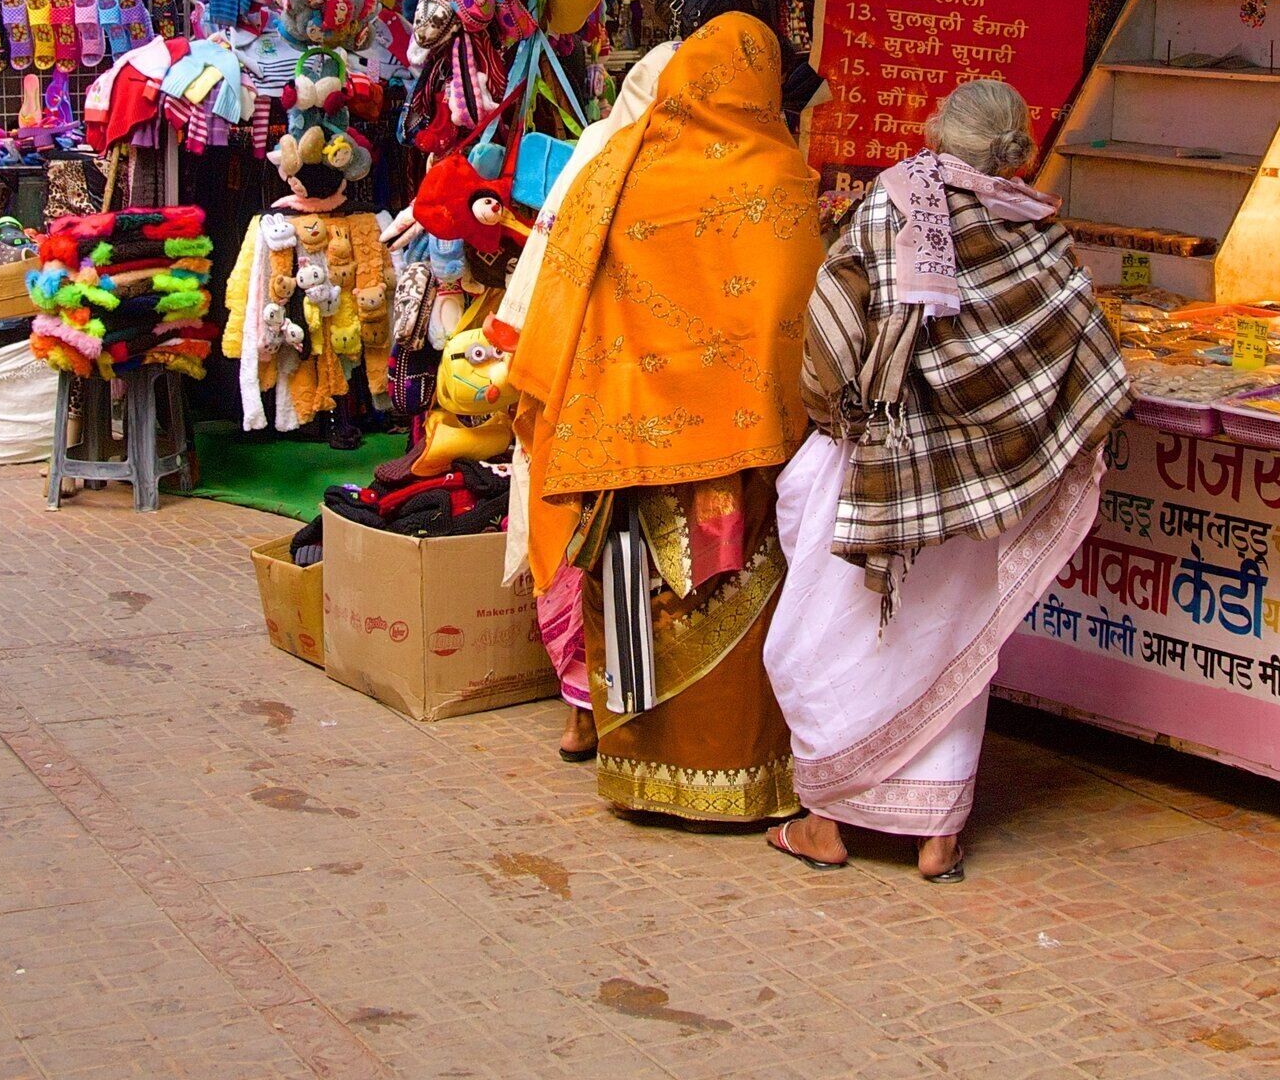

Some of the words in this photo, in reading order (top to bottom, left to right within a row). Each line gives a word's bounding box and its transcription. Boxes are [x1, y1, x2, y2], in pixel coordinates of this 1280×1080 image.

[845, 2, 877, 22] 13.
[886, 8, 966, 36] चुलबुली
[971, 14, 1030, 40] ईमली
[842, 29, 874, 49] 14.
[883, 36, 945, 59] सुरभी
[950, 44, 1017, 66] सुपारी
[839, 57, 871, 77] 15.
[880, 63, 949, 84] सन्तरा
[836, 85, 868, 104] 16.
[876, 85, 929, 110] सौंफ
[833, 113, 864, 131] 17.
[865, 138, 913, 161] मैथी
[1159, 500, 1210, 544] राम
[1209, 511, 1272, 570] लड्डू
[476, 607, 516, 619] Makers
[517, 604, 529, 614] of
[1086, 603, 1138, 658] गोली
[1139, 629, 1189, 672] आम
[1191, 642, 1256, 691] पापड
